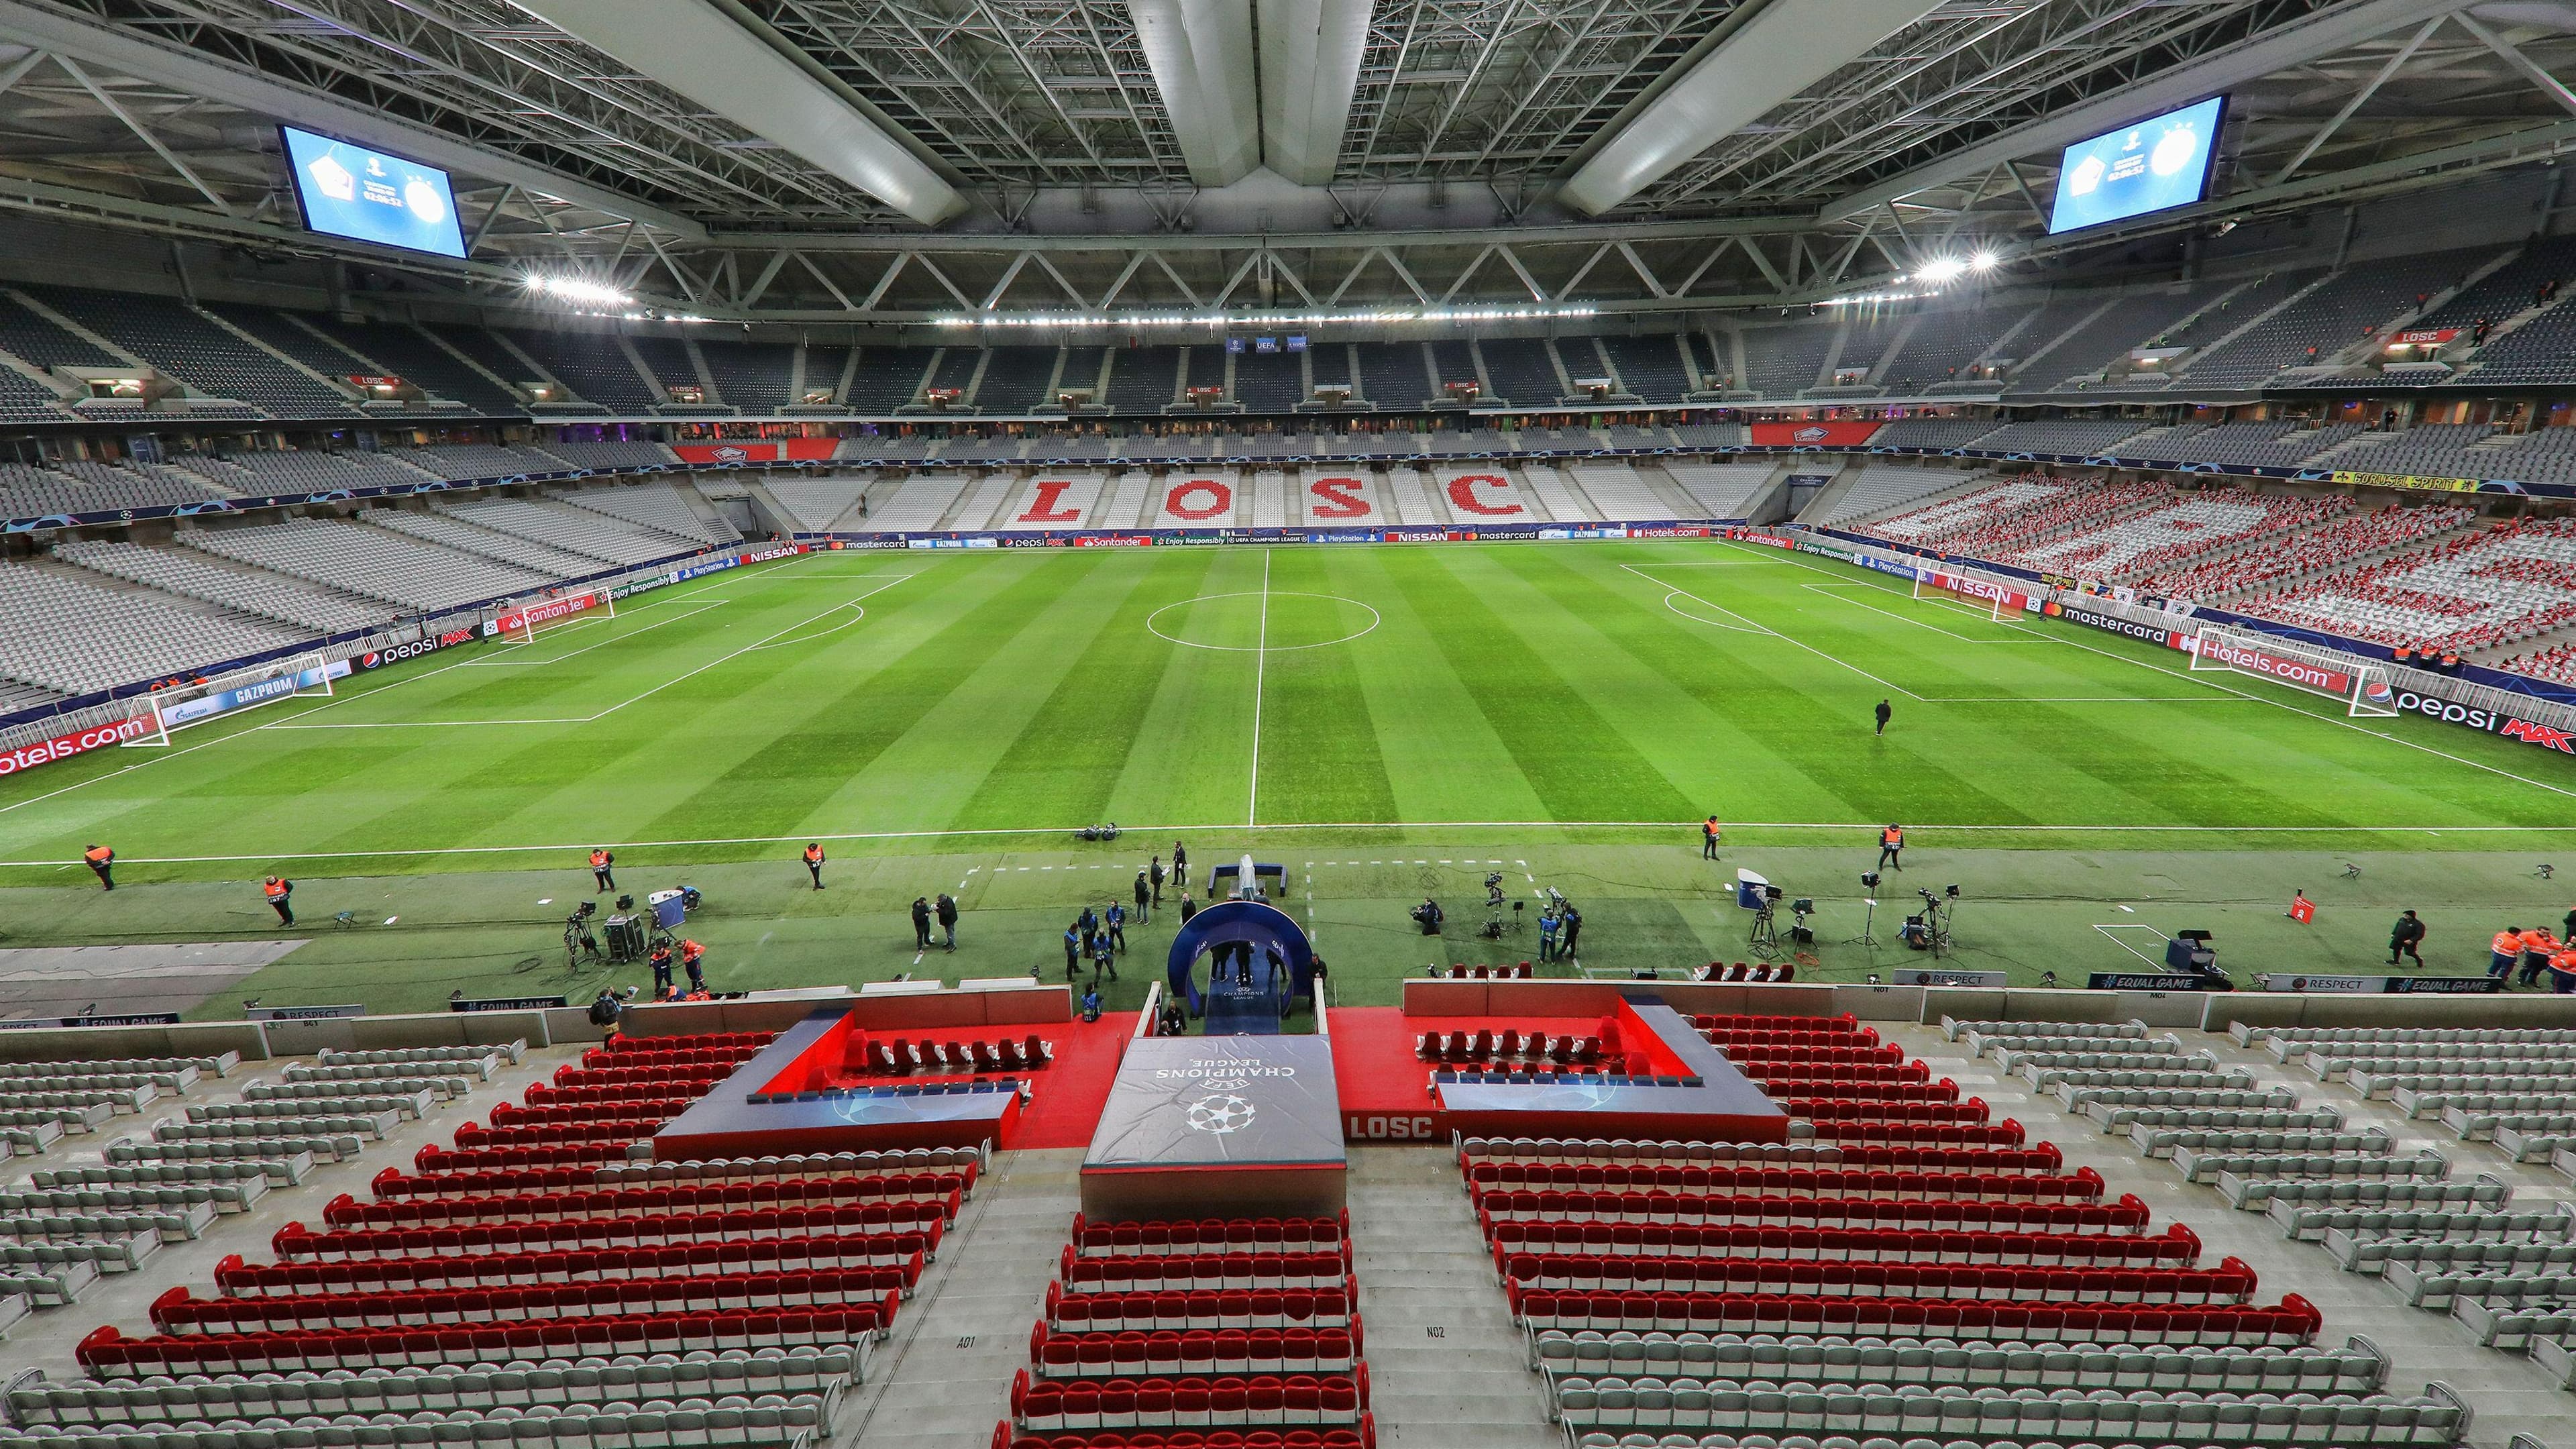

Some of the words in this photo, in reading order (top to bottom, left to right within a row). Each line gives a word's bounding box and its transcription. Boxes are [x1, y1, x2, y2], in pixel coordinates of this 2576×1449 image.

[2402, 331, 2438, 342] LOSC
[2411, 476, 2457, 490] SPIRIT
[1328, 534, 1364, 543] PlayStation
[1398, 533, 1448, 542] NISSAN
[1480, 531, 1536, 540] mastercard
[1574, 530, 1600, 538] GAZPROM
[846, 539, 905, 549] mastercard
[936, 539, 961, 547] GAZPROM
[1016, 538, 1044, 548] pepsi
[1046, 537, 1067, 547] MAX
[1093, 538, 1141, 547] Santander
[1165, 537, 1184, 547] Enjoy
[1185, 537, 1225, 546] Responsibly
[750, 545, 798, 564] NISSAN
[1803, 542, 1819, 555] Enjoy
[1820, 547, 1854, 562] Responsibly
[694, 561, 724, 576] PlayStation
[1878, 561, 1914, 578] PlayStation
[610, 588, 629, 600] Enjoy
[631, 575, 669, 594] Responsibly
[1947, 577, 2010, 604] NISSAN
[524, 598, 587, 624] Santander
[2065, 608, 2166, 643] mastercard
[384, 635, 438, 663] pepsi
[440, 627, 474, 648] MAX
[235, 677, 293, 704] GAZPROM
[2397, 693, 2498, 731] pepsi
[2500, 718, 2576, 755] MAX
[1933, 975, 1984, 984] RESPECT
[2157, 977, 2193, 989] GAME
[2310, 979, 2363, 989] RESPECT
[2452, 981, 2489, 991] GAME
[1192, 1059, 1261, 1067] LEAGUE
[1155, 1067, 1295, 1079] CHAMPIONS
[1204, 1078, 1247, 1089] UEFA
[1351, 1117, 1432, 1138] LOSC
[1426, 1326, 1445, 1338] N02
[957, 1336, 975, 1348] A01
